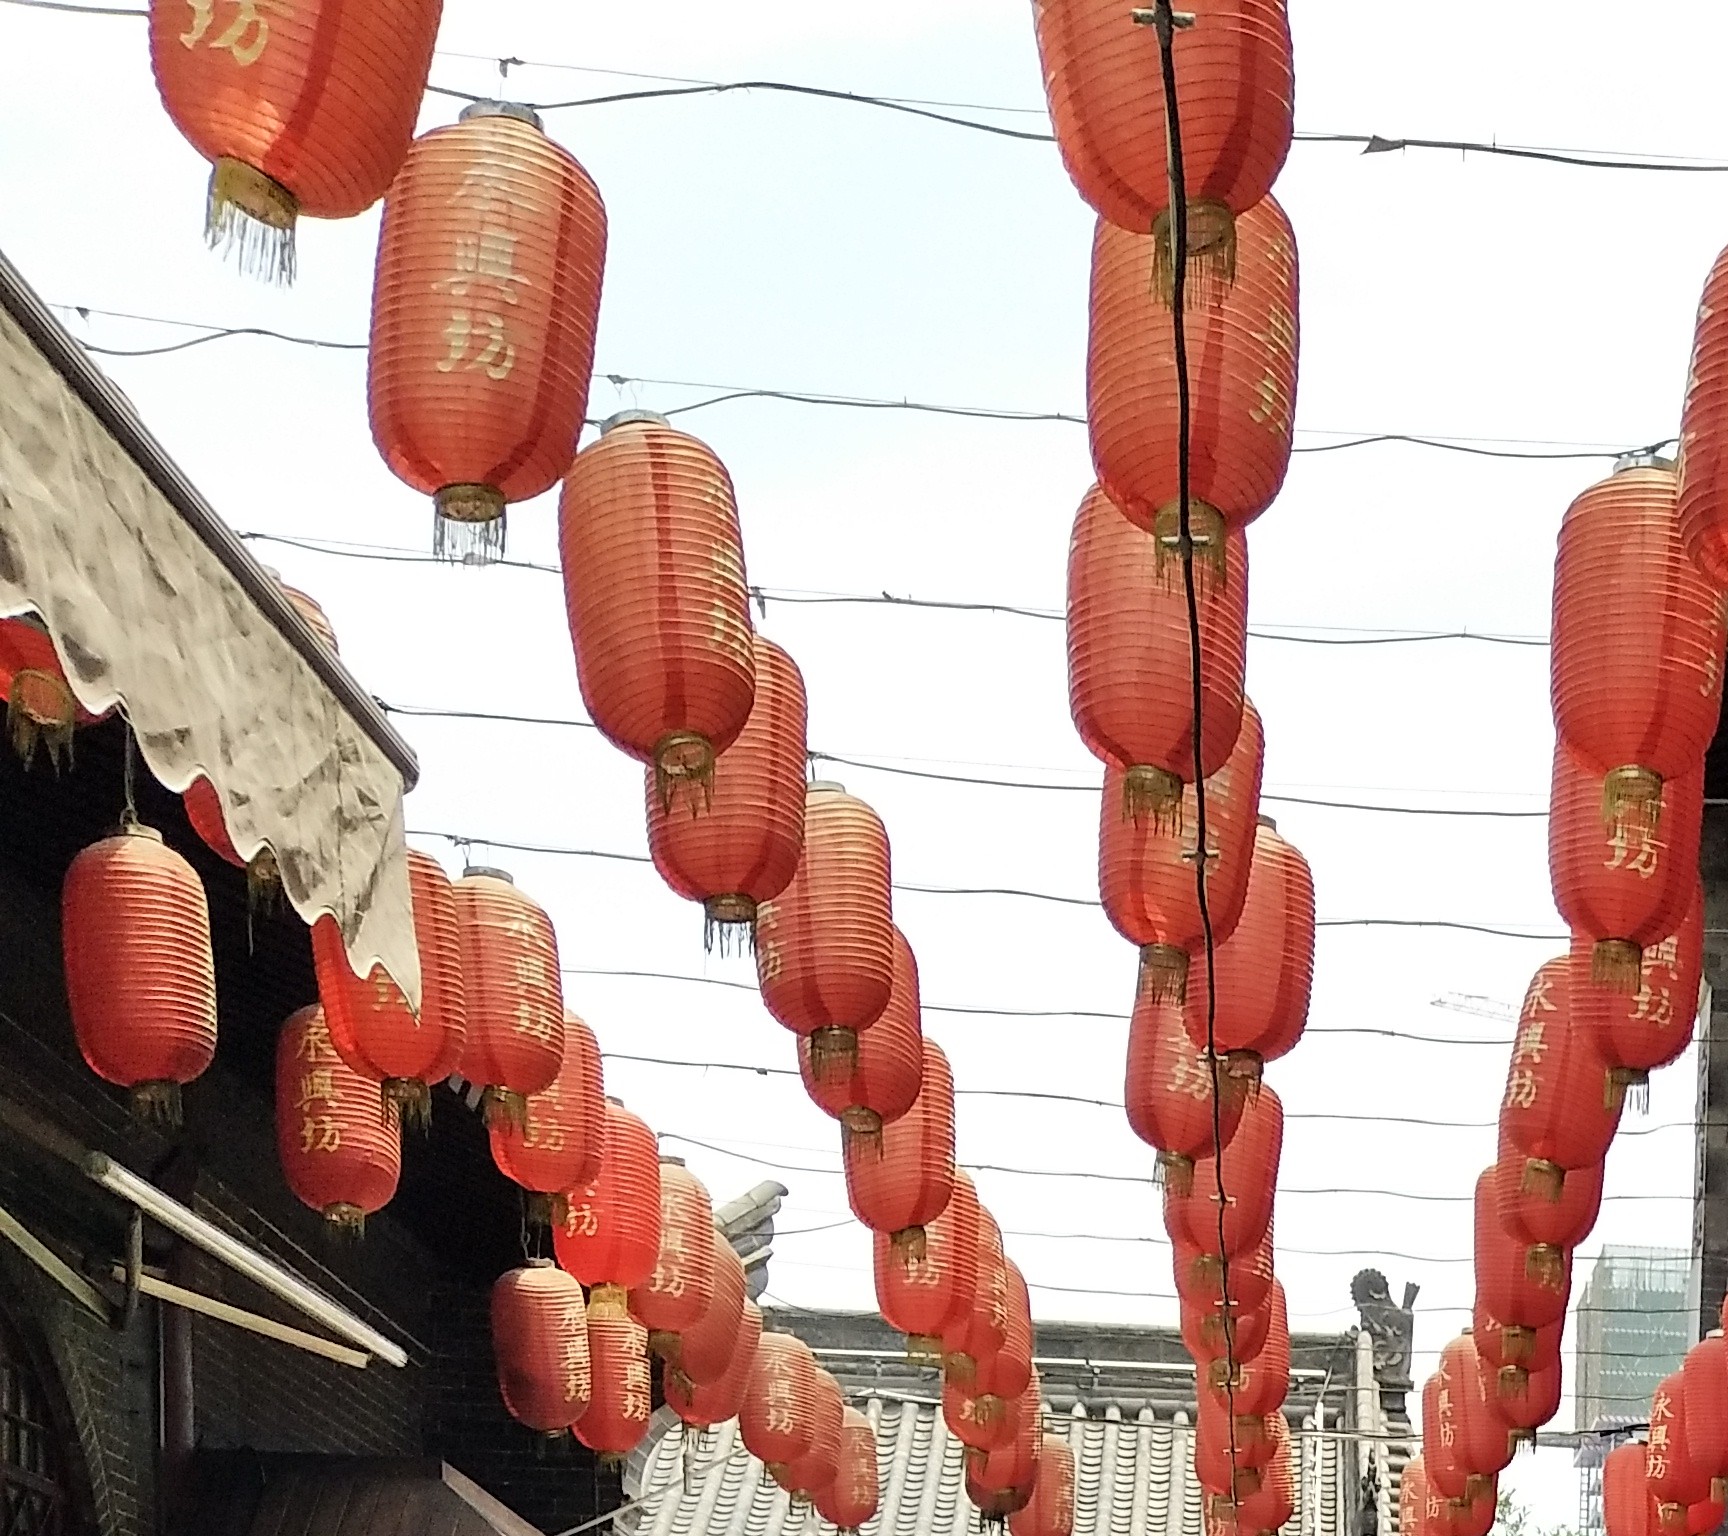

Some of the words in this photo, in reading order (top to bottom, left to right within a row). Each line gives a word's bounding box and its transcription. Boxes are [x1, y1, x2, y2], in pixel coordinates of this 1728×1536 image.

[295, 1015, 350, 1154] 永興坊
[1503, 973, 1558, 1109] 永興坊
[763, 1352, 796, 1436] 永興坊
[1646, 1391, 1675, 1479] 永興坊
